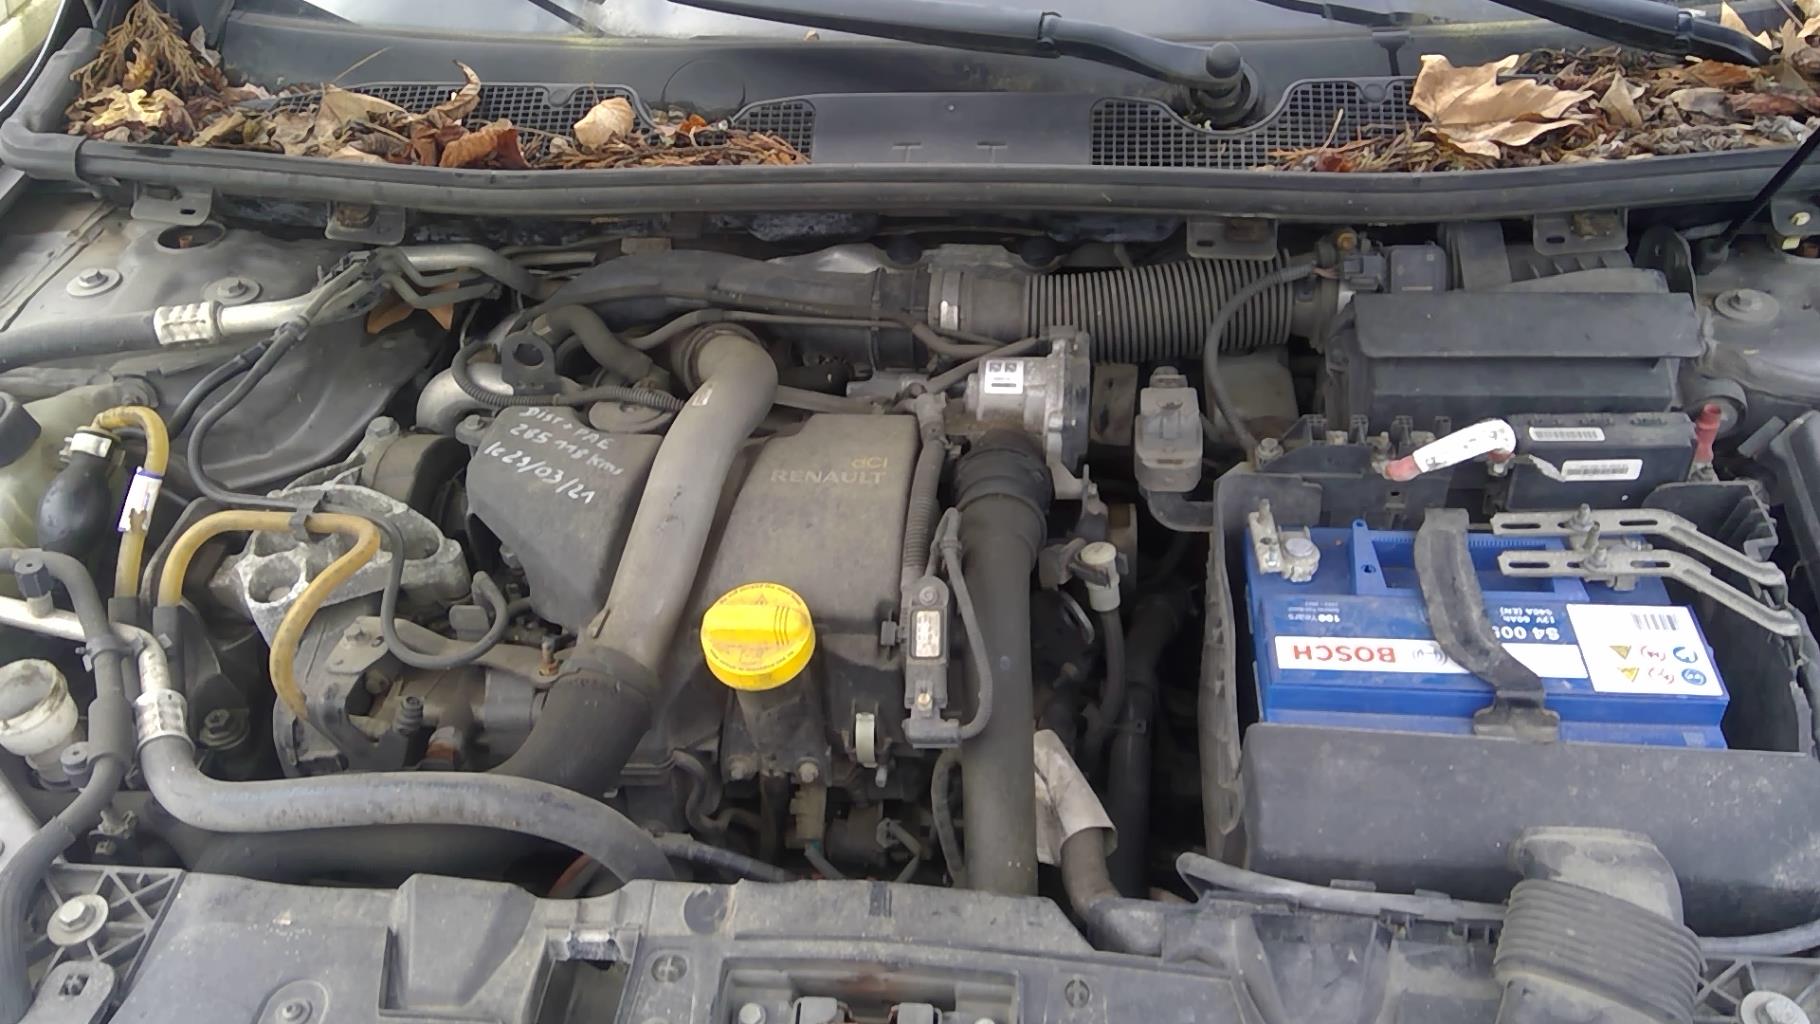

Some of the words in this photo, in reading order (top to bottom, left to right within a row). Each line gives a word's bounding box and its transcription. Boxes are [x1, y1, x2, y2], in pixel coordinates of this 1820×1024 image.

[770, 469, 887, 485] RENAULT
[1318, 613, 1340, 622] 100
[1532, 626, 1560, 641] S4
[1293, 645, 1396, 663] BOSCH
